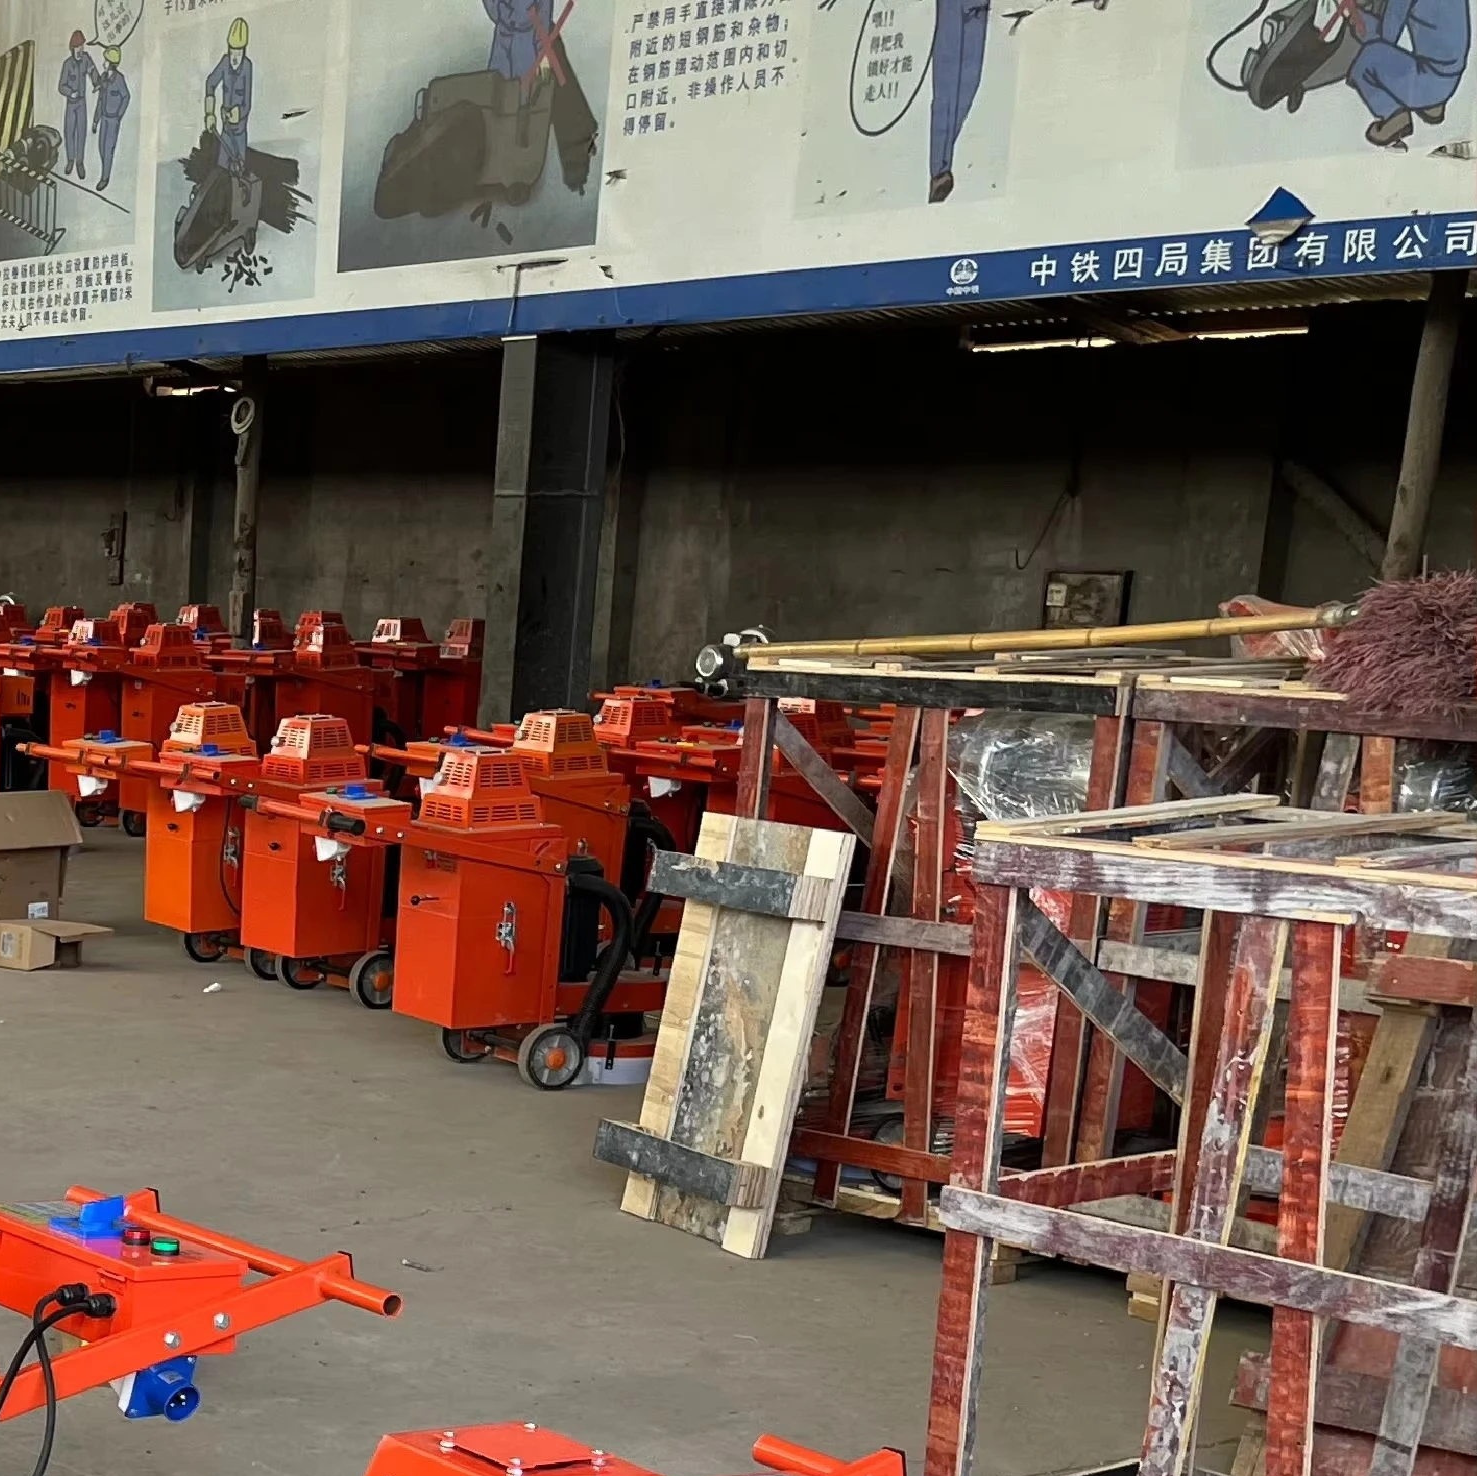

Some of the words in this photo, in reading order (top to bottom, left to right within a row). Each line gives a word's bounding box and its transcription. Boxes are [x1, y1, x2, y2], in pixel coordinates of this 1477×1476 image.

[630, 0, 791, 33] 严禁用手直接清除
[628, 40, 788, 86] 在钢筋摆动范围内和切
[622, 112, 676, 136] 得停留。
[1030, 221, 1477, 287] 中铁四局集团有限公司
